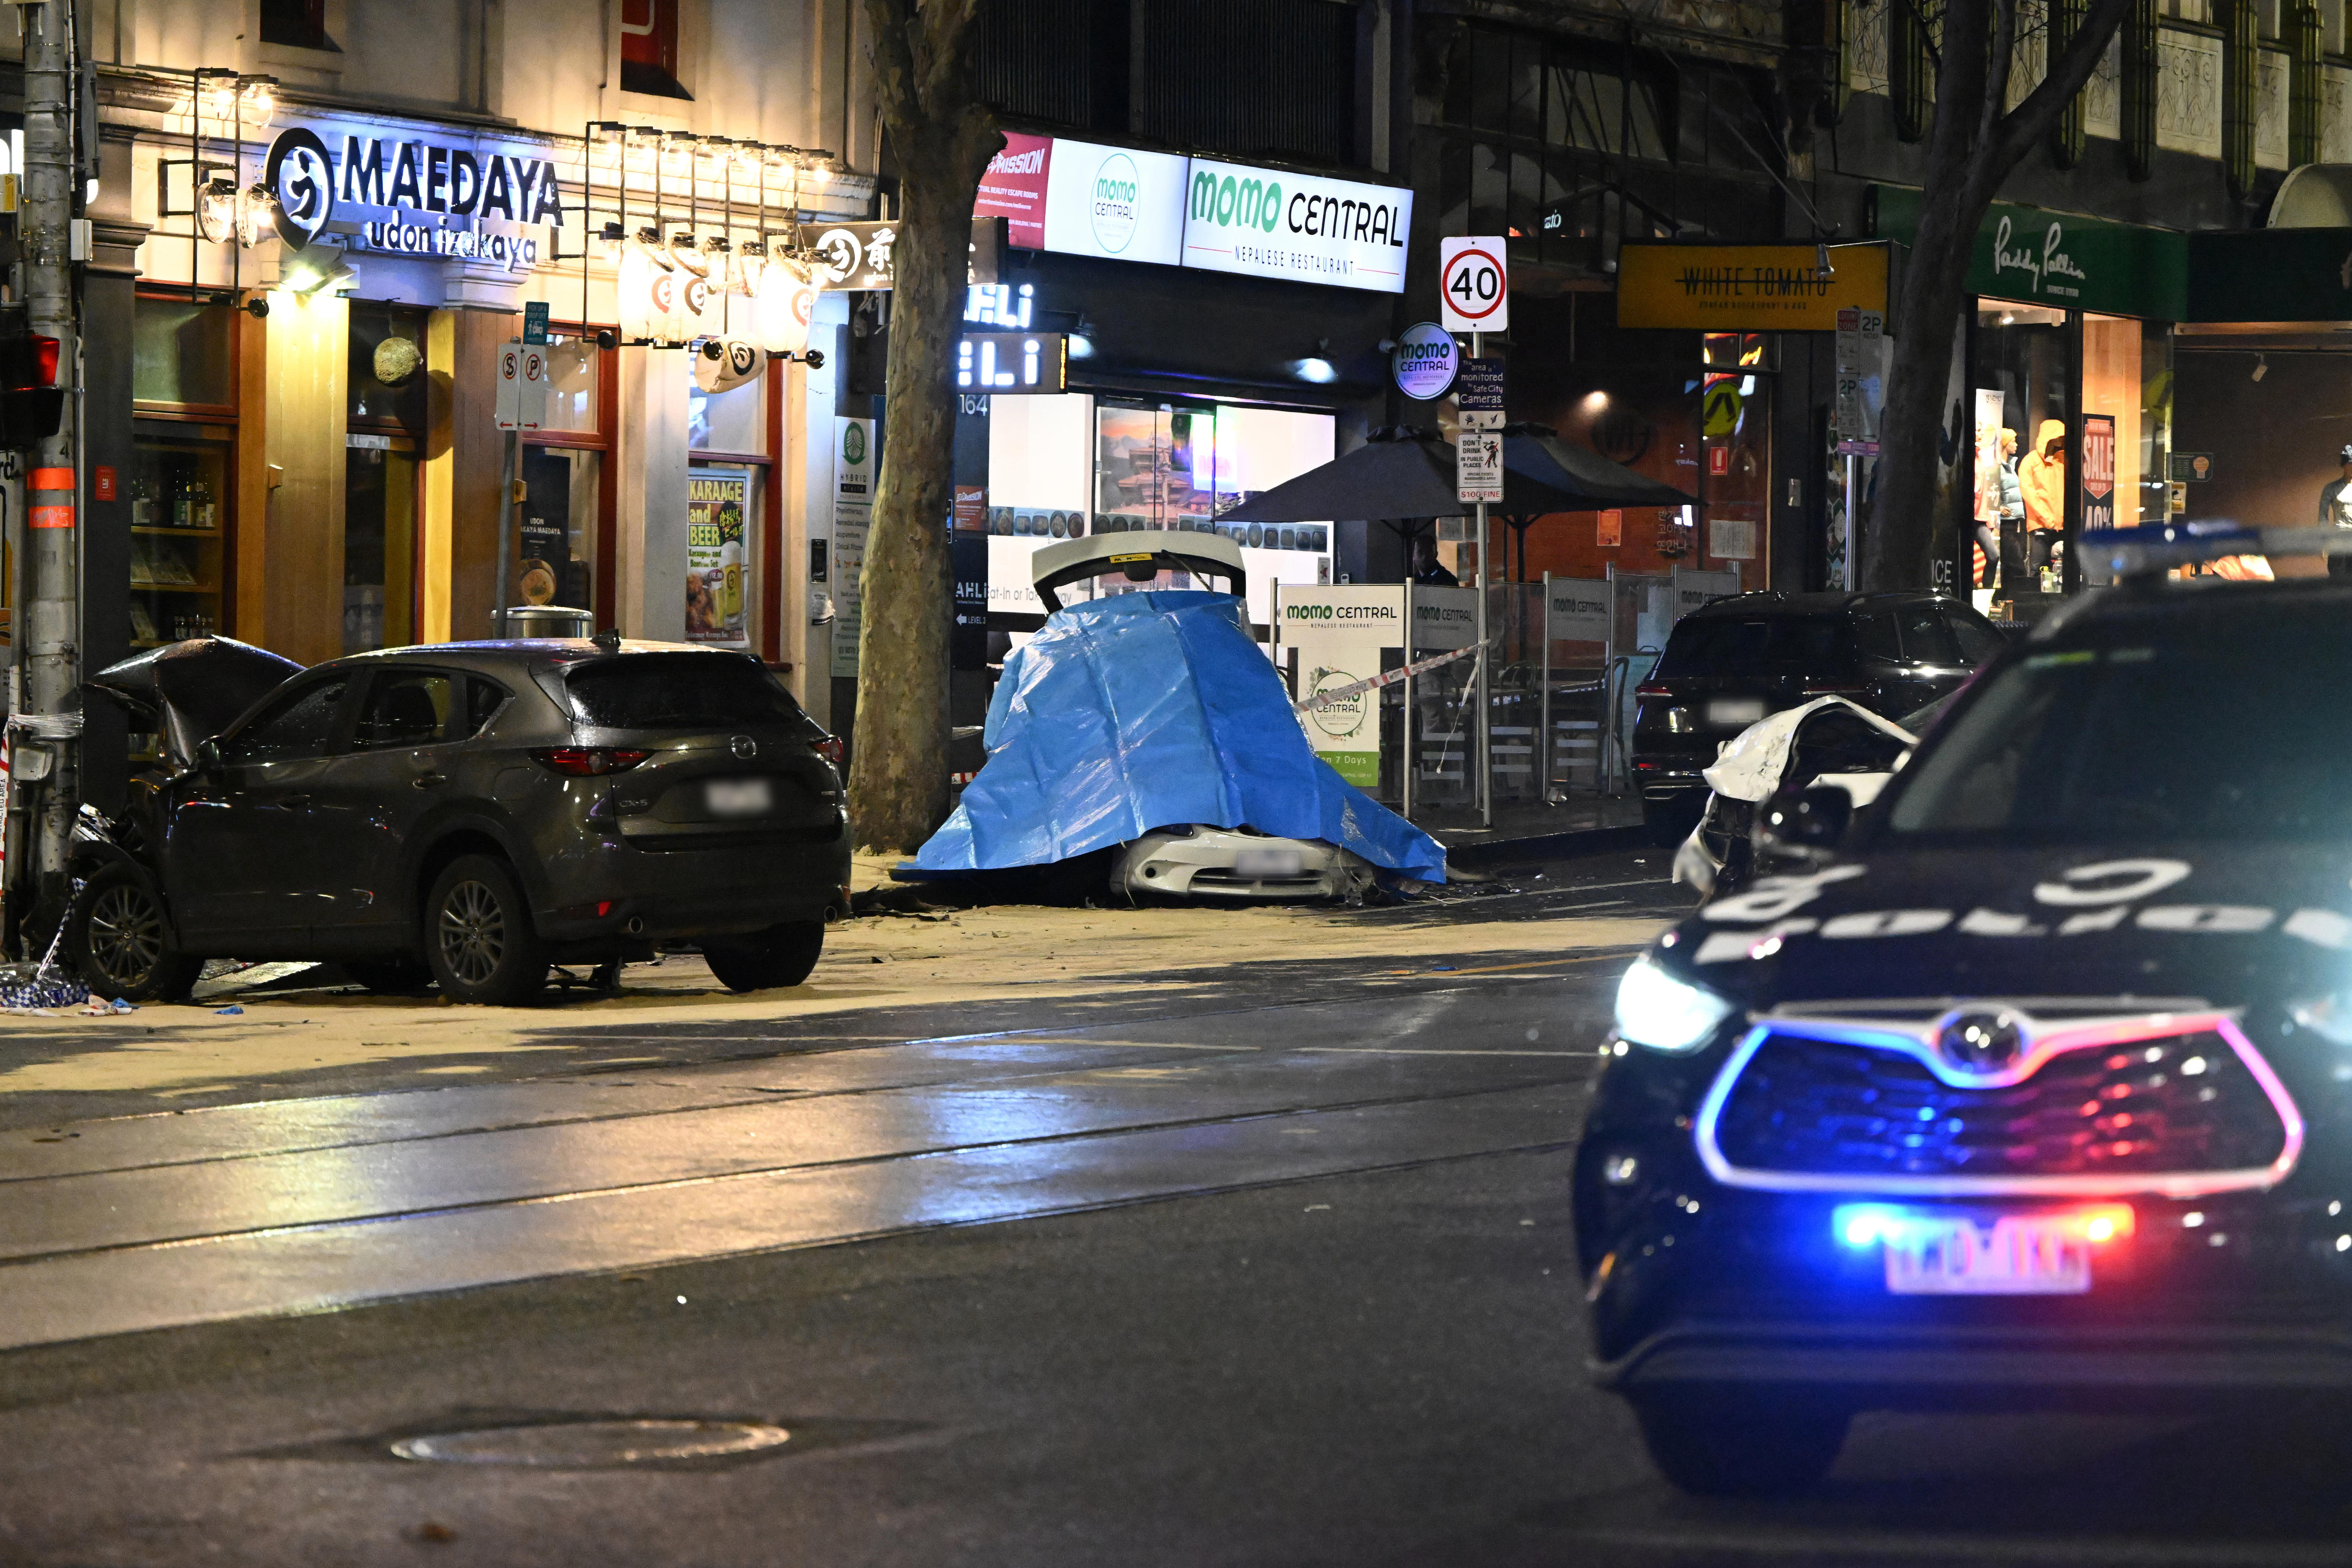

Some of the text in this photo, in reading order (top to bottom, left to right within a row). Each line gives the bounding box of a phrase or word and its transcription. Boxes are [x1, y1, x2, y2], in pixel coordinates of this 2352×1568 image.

[996, 148, 1045, 174] MISSION
[338, 135, 564, 226] MAEDAYA
[1008, 189, 1023, 198] ESCAPE
[1097, 178, 1136, 203] MOMO
[1096, 202, 1133, 220] CENTRAL
[1192, 171, 1403, 247] MOMO CENTRAL
[368, 210, 536, 273] udon izakaya
[1235, 245, 1354, 276] NEPALESE RESTAURANT
[1451, 267, 1497, 300] 40
[1684, 267, 1743, 296] WHITE
[1862, 317, 1881, 331] 2P
[1401, 342, 1450, 359] MOMO
[530, 360, 539, 375] P
[1401, 361, 1449, 371] CENTRAL
[1461, 372, 1503, 382] monitored
[1488, 384, 1503, 394] City
[959, 394, 988, 416] 164
[1460, 393, 1502, 404] Cameras
[60, 441, 69, 459] 4
[2083, 435, 2114, 480] SALE
[840, 473, 866, 483] HYBRID
[689, 480, 743, 501] KARAAGE
[689, 503, 711, 523] and
[690, 525, 720, 546] BEER
[955, 582, 987, 598] AHLi
[1014, 591, 1022, 600] or
[1287, 605, 1397, 620] MOMO CENTRAL
[1417, 605, 1473, 622] MOMO CENTRAL
[1578, 601, 1606, 613] CENTRAL
[1317, 704, 1361, 713] CENTRAL
[1344, 756, 1367, 765] Days
[619, 799, 648, 807] CX-5
